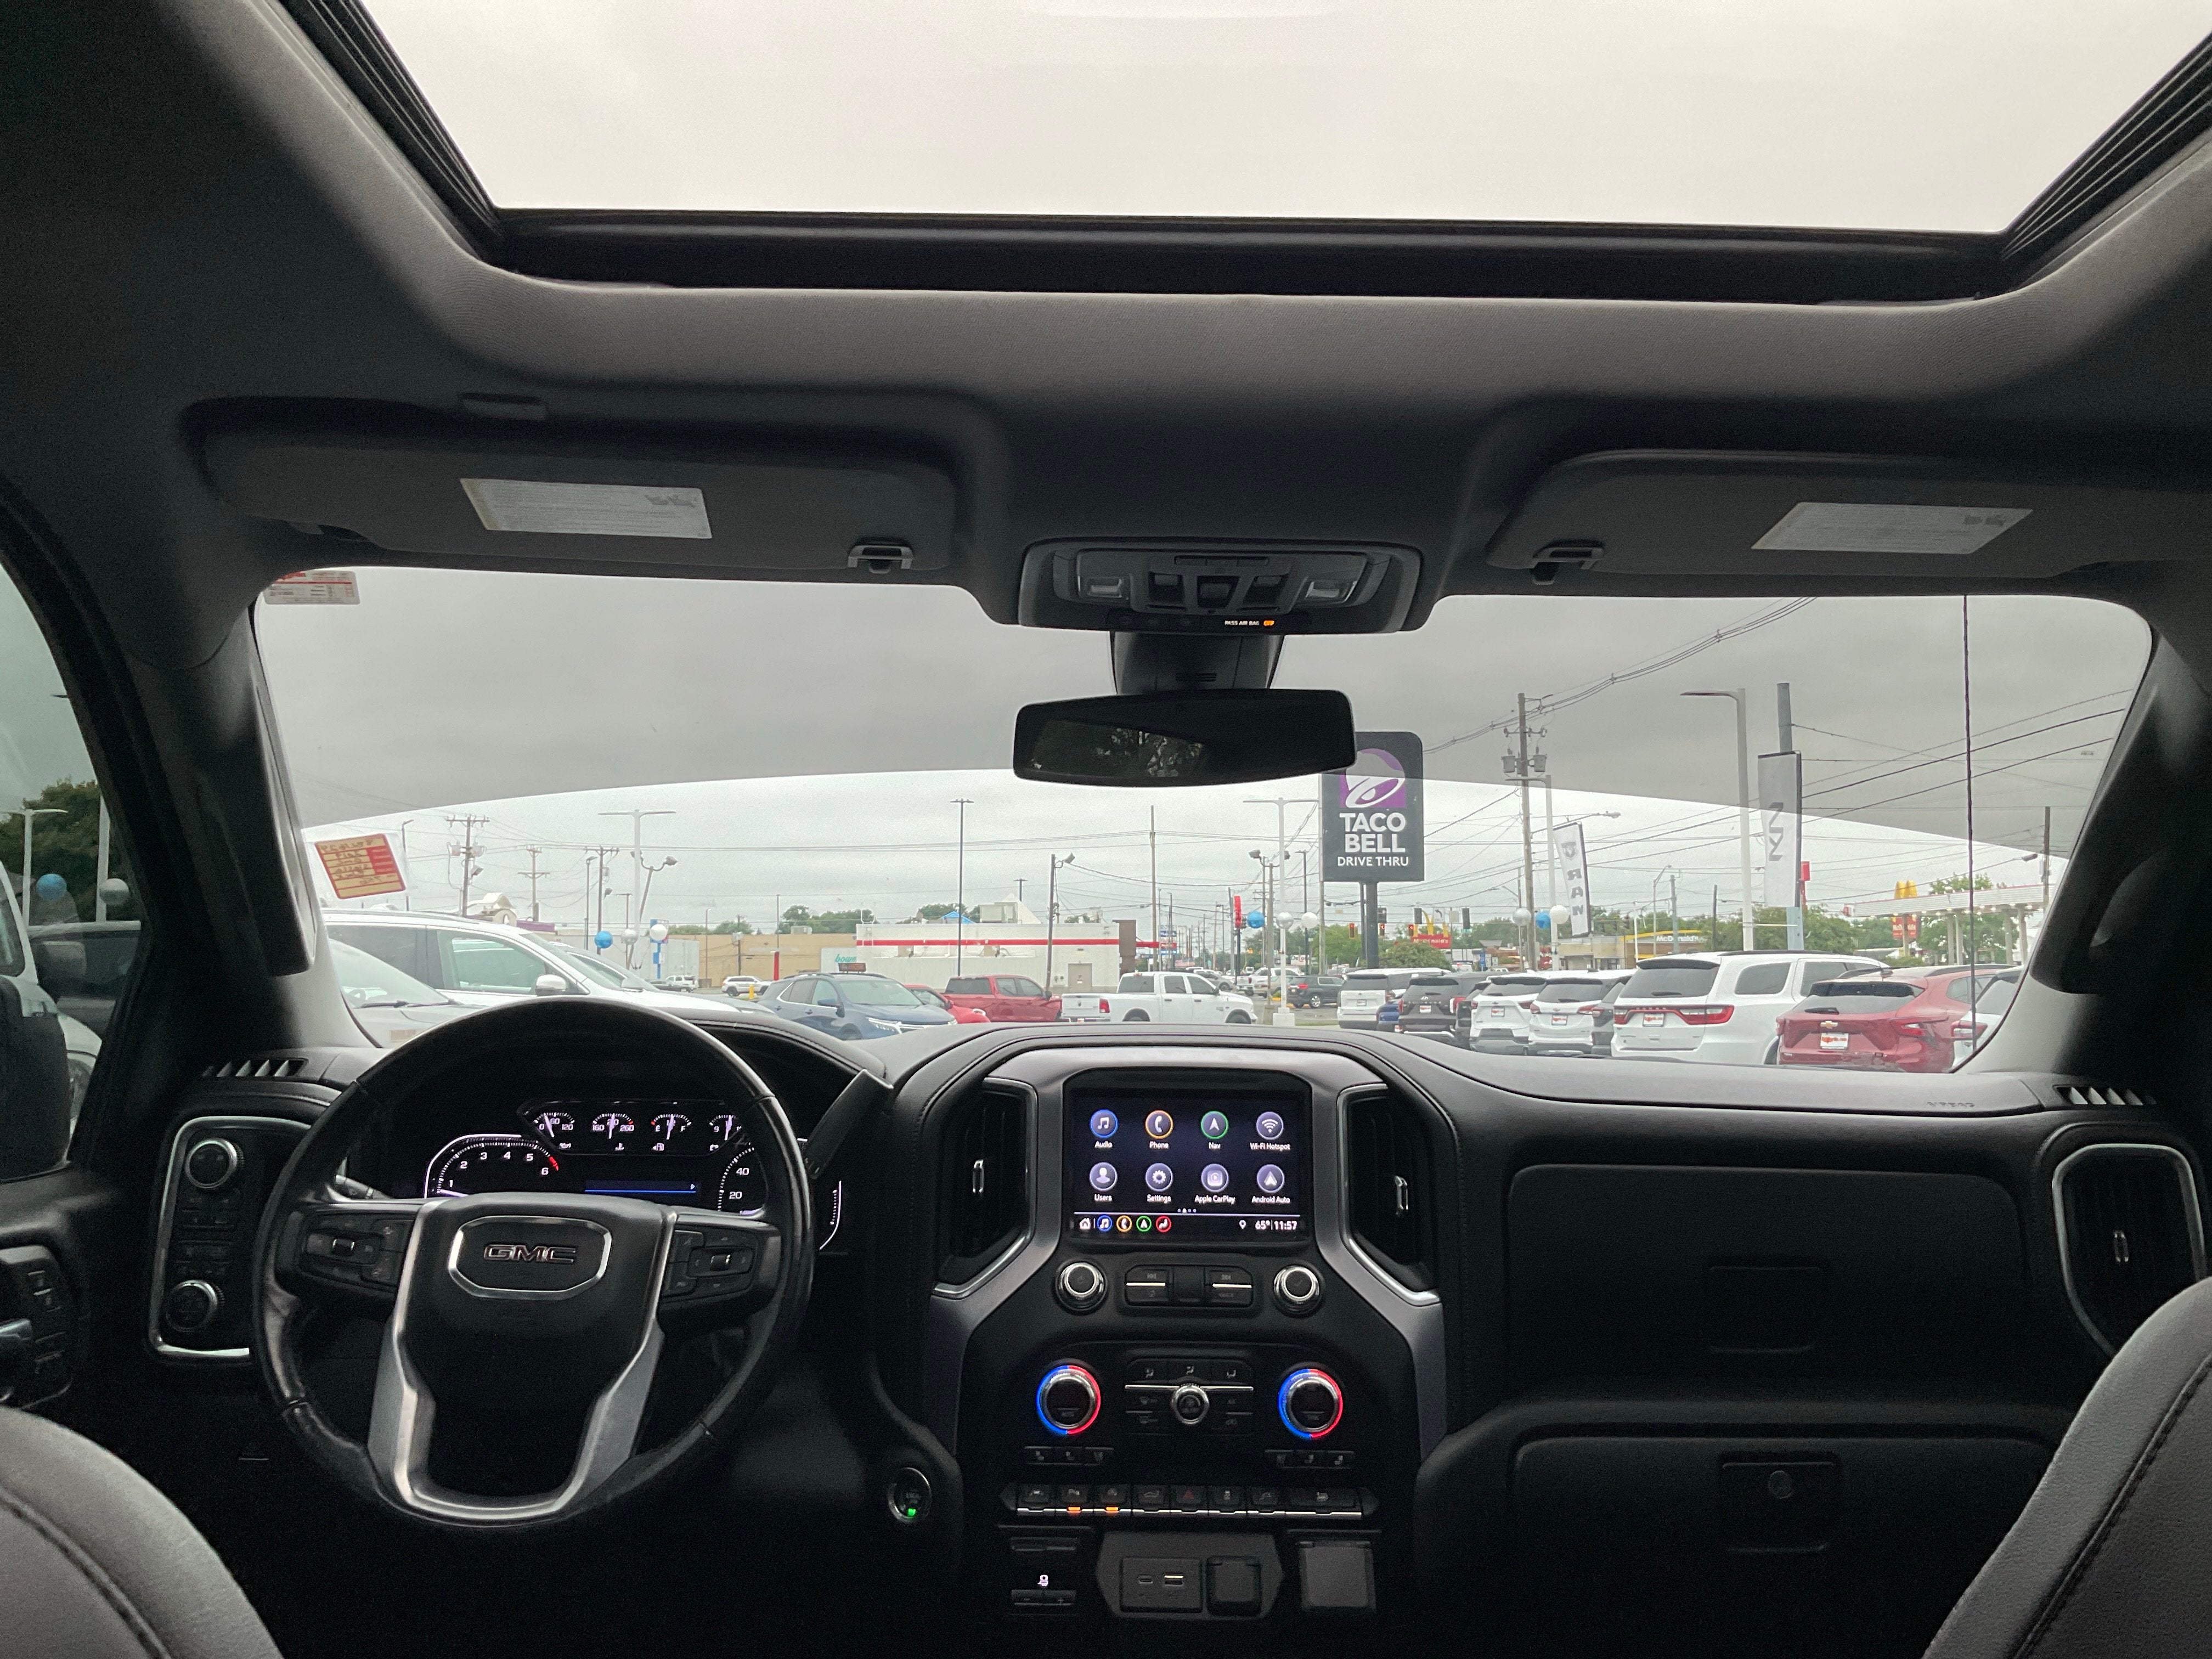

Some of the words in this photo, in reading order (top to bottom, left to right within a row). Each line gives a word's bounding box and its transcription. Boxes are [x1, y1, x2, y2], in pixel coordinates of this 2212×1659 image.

[1339, 812, 1406, 832] TACO
[1345, 833, 1406, 853] BELL
[1338, 856, 1373, 866] DRIVE
[1375, 856, 1409, 866] THRU
[1266, 1143, 1291, 1152] Hotspot
[480, 1152, 488, 1160] 3
[503, 1151, 511, 1160] 4
[526, 1153, 534, 1161] 5
[460, 1161, 468, 1169] 2
[541, 1167, 549, 1176] 6
[736, 1167, 749, 1176] 40
[448, 1180, 454, 1188] 1
[729, 1191, 742, 1199] 20
[1147, 1194, 1172, 1204] Settings
[1252, 1195, 1276, 1204] Android
[1194, 1195, 1212, 1204] Apple
[1212, 1195, 1235, 1205] CarPlay
[1274, 1221, 1297, 1231] 11:57
[483, 1243, 577, 1264] GMC
